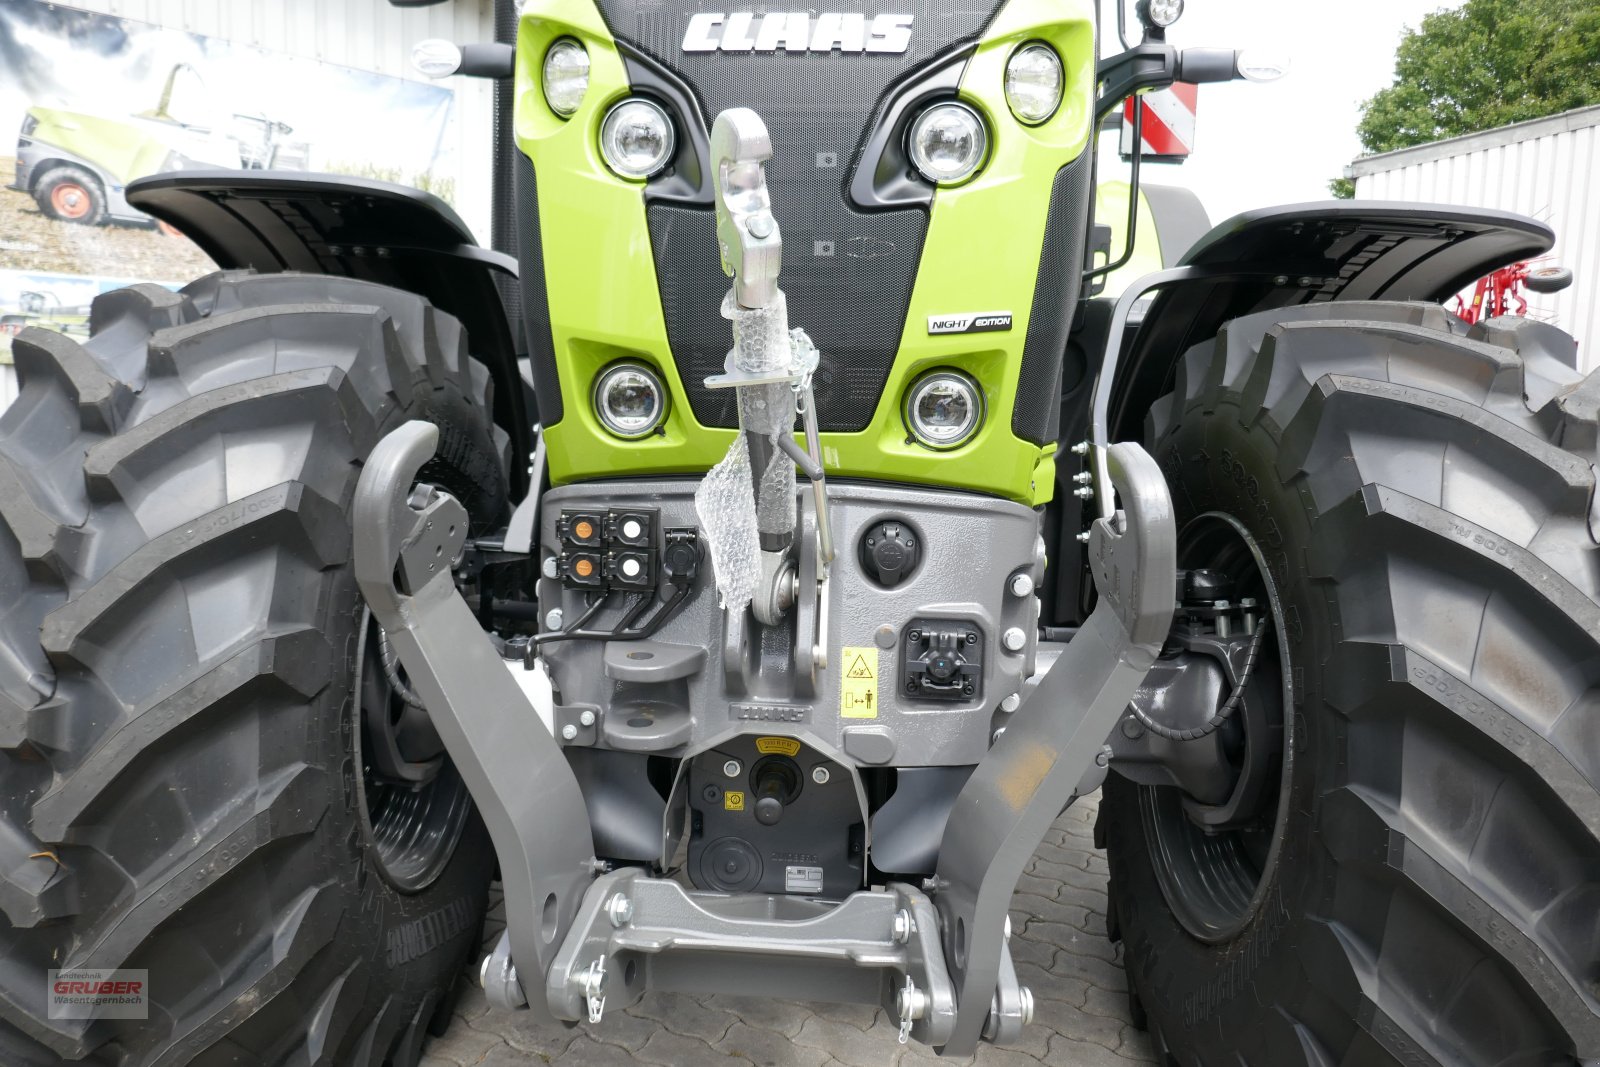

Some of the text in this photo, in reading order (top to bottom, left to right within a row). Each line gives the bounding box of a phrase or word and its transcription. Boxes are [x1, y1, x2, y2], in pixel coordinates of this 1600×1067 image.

[682, 12, 914, 53] CLAAS
[932, 317, 1011, 329] NIGHT EDITION
[1445, 519, 1508, 559] TM 900
[737, 706, 804, 722] CLAAS
